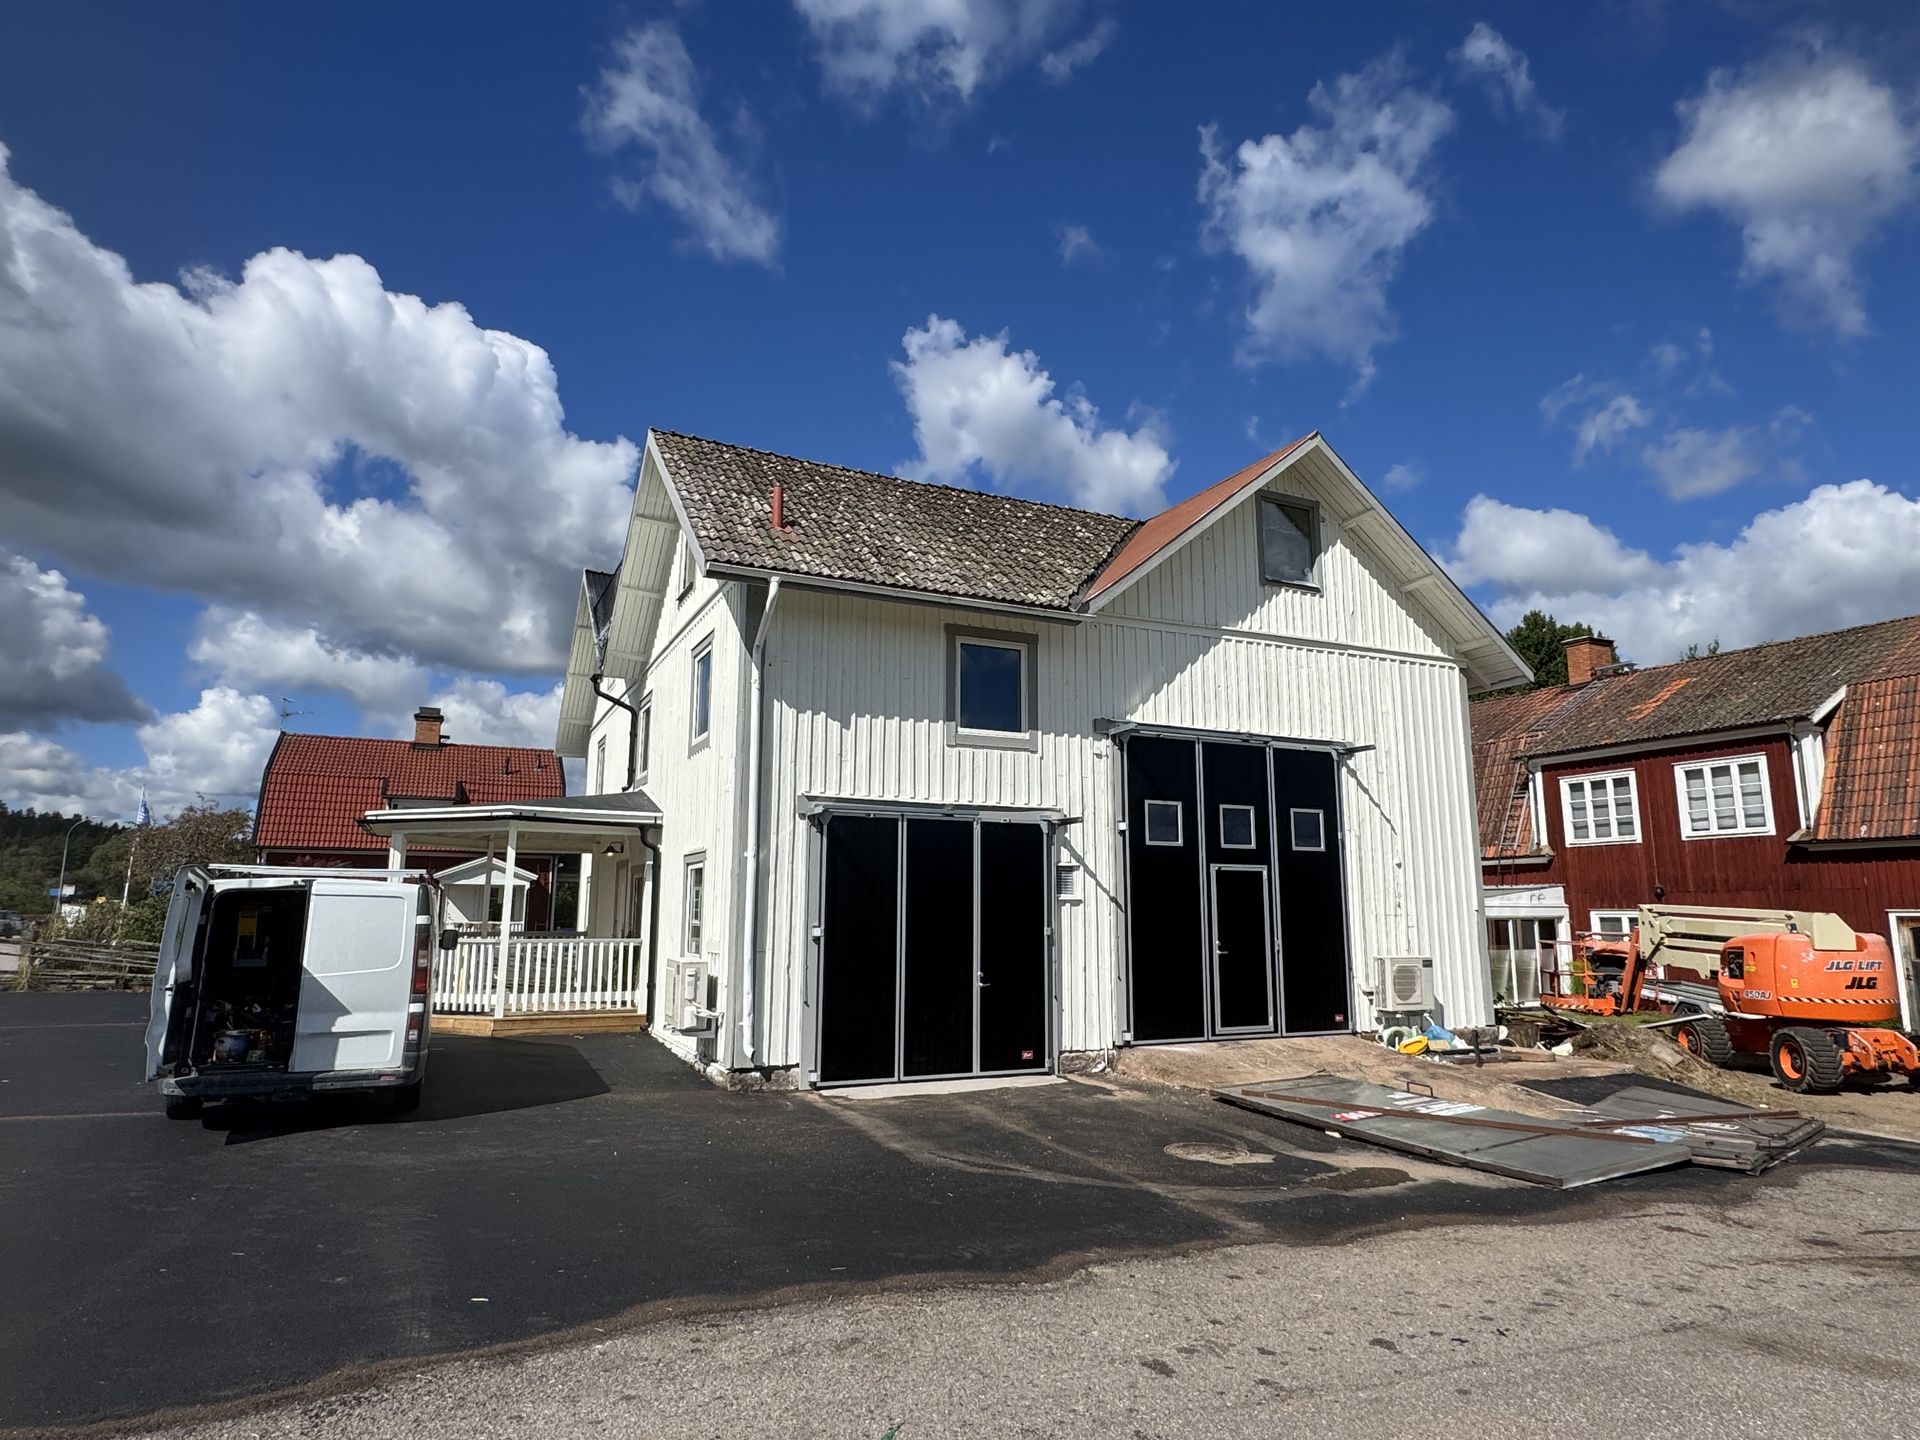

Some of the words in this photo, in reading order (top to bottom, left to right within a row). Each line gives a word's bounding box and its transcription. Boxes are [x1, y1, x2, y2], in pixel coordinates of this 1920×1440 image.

[1825, 960, 1854, 971] JLG
[1857, 960, 1883, 971] LIFT
[1844, 976, 1878, 990] JLG
[1743, 989, 1772, 1000] 450AJ
